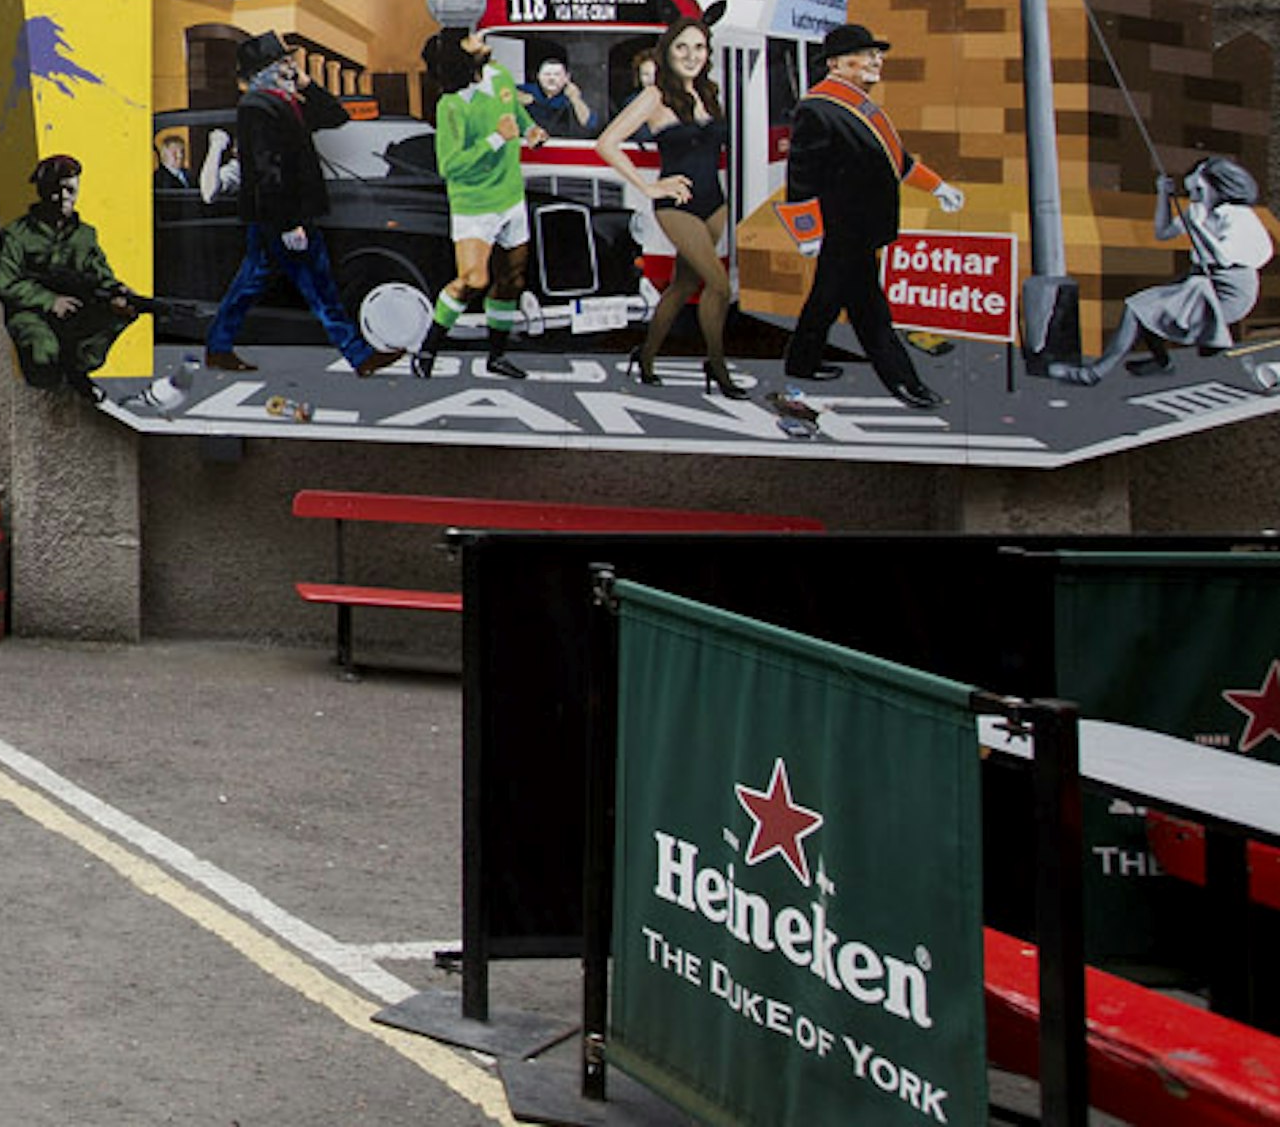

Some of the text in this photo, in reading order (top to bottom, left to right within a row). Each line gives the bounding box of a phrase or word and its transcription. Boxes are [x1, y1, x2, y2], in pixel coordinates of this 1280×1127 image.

[892, 240, 1000, 276] bóthar
[887, 278, 1007, 316] druidte
[184, 381, 1050, 450] LANE
[654, 829, 933, 1029] Heineken
[641, 924, 949, 1124] THE DUKE OF YORK
